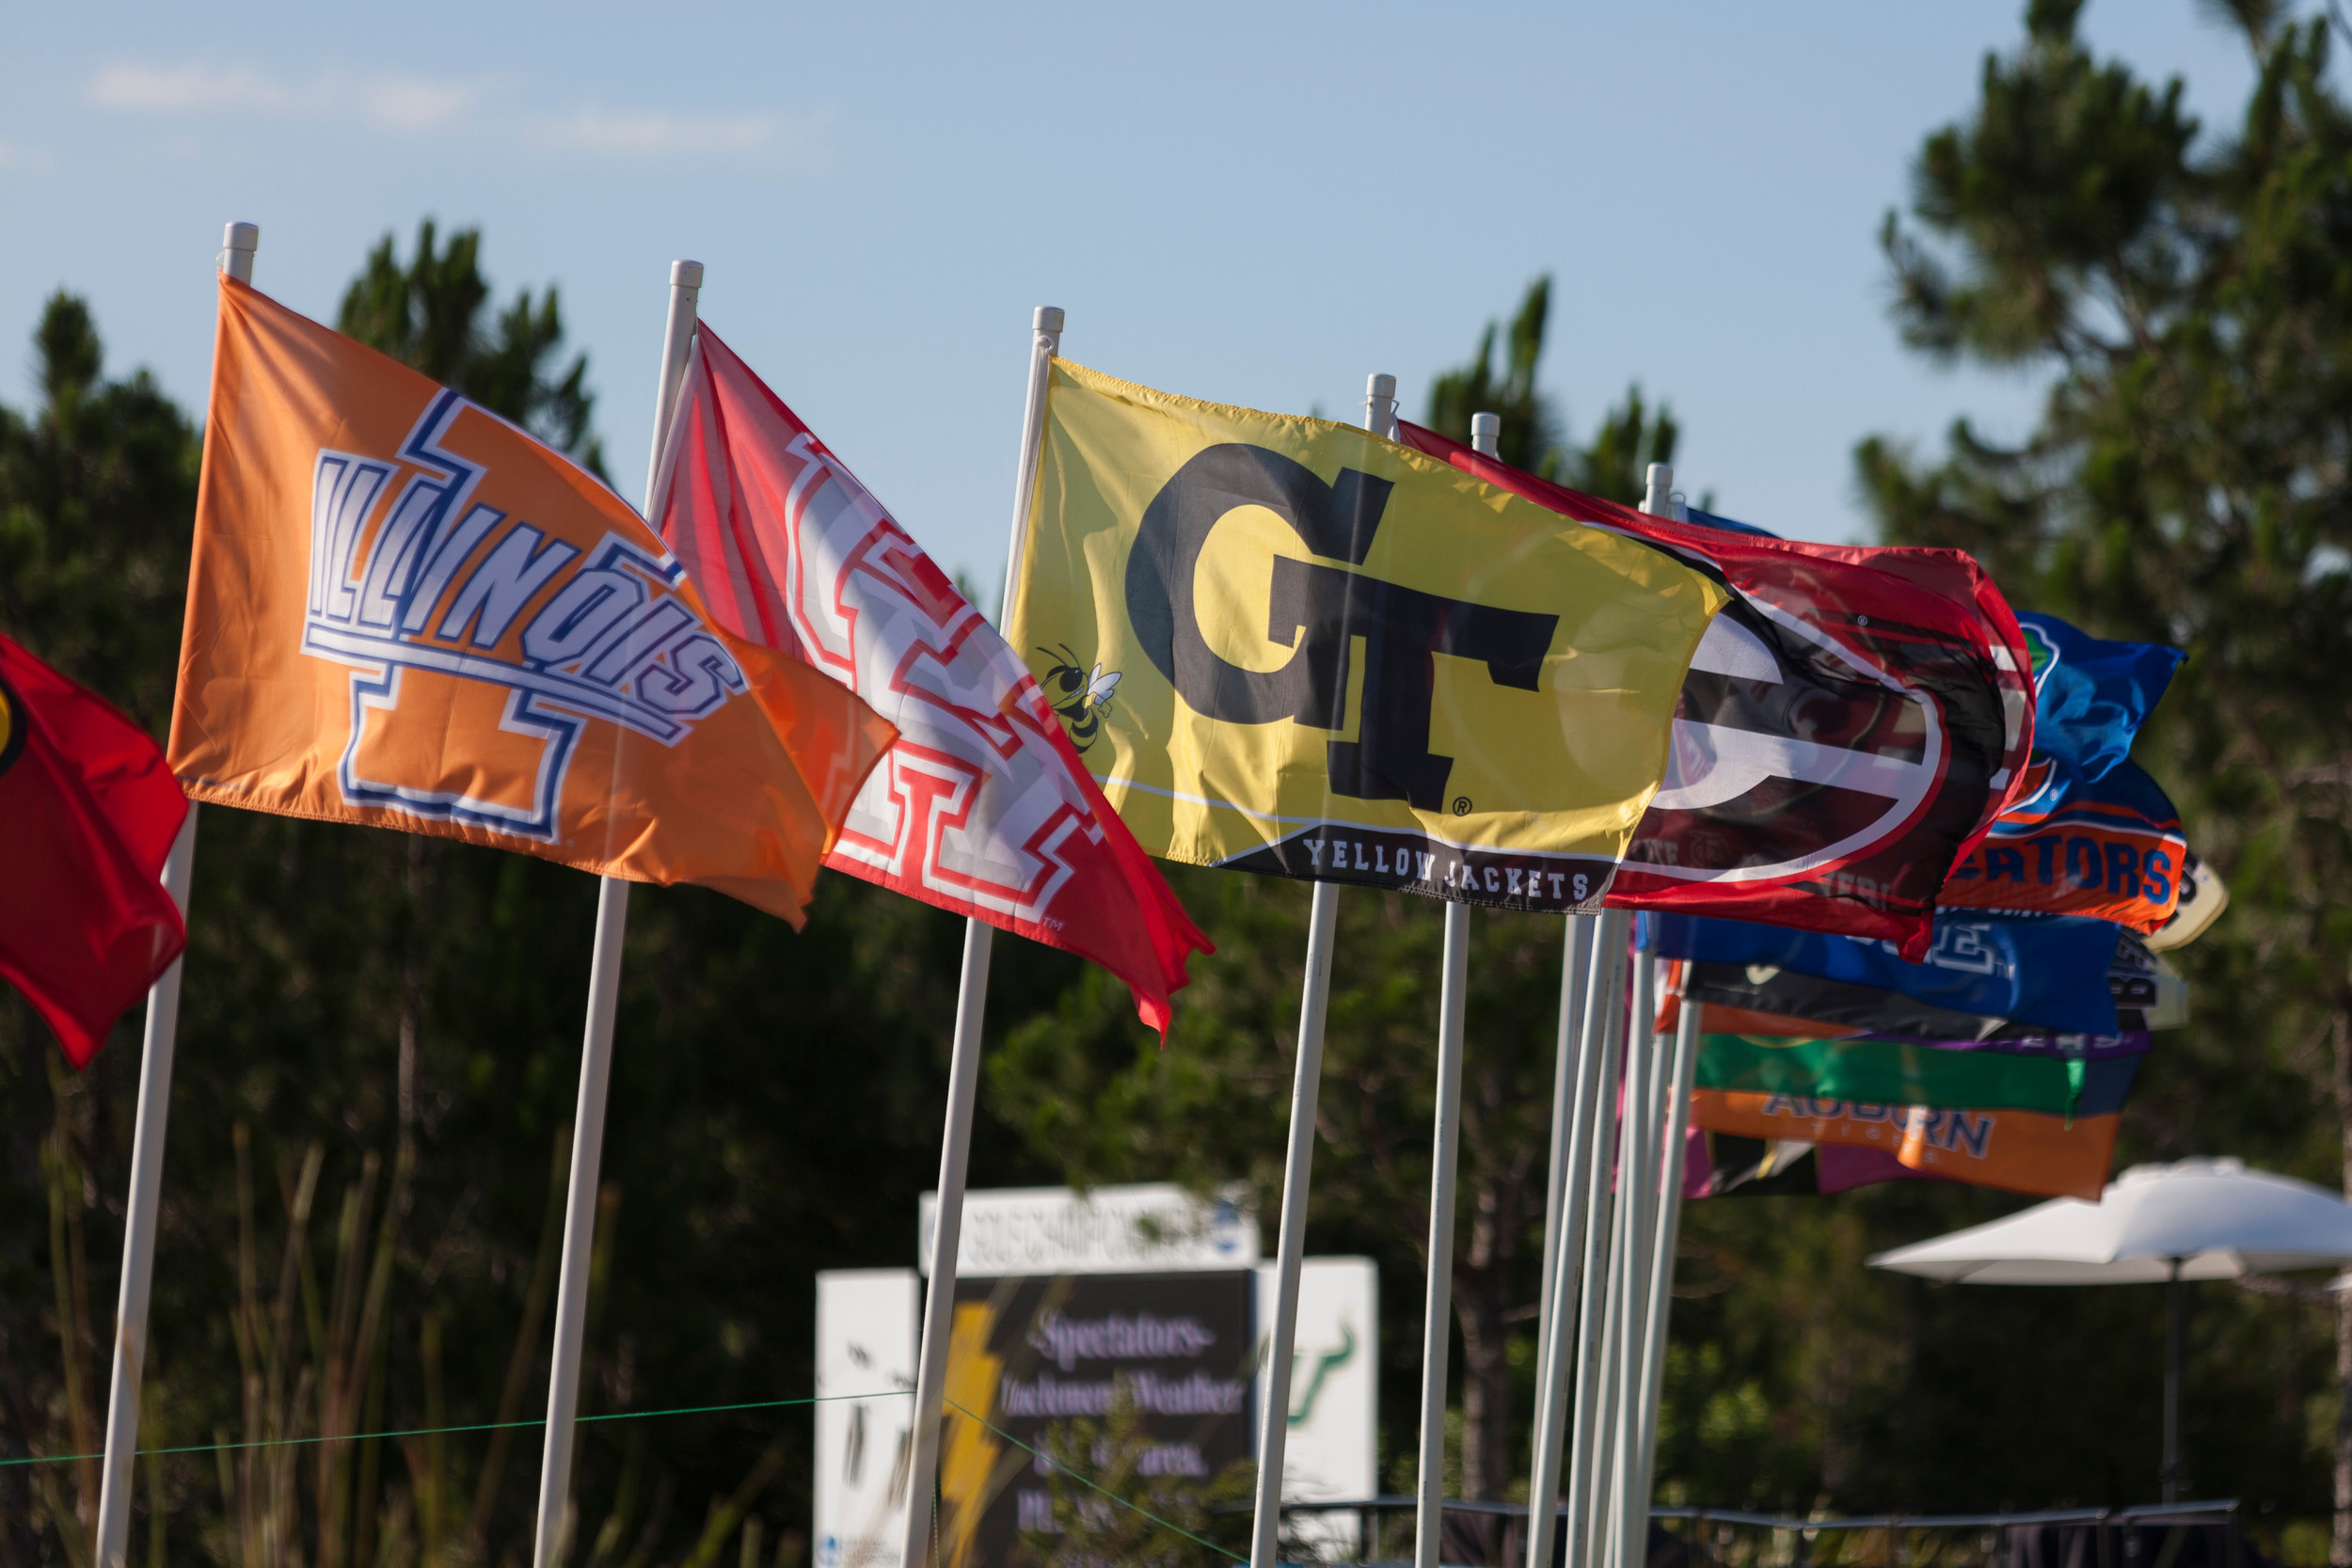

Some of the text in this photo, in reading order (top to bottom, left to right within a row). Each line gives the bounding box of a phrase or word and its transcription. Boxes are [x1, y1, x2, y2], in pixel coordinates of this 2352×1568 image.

[309, 447, 751, 721] ILLINOIS
[1124, 442, 1561, 815] GT
[1302, 838, 1589, 901] YELLOW JACKETS
